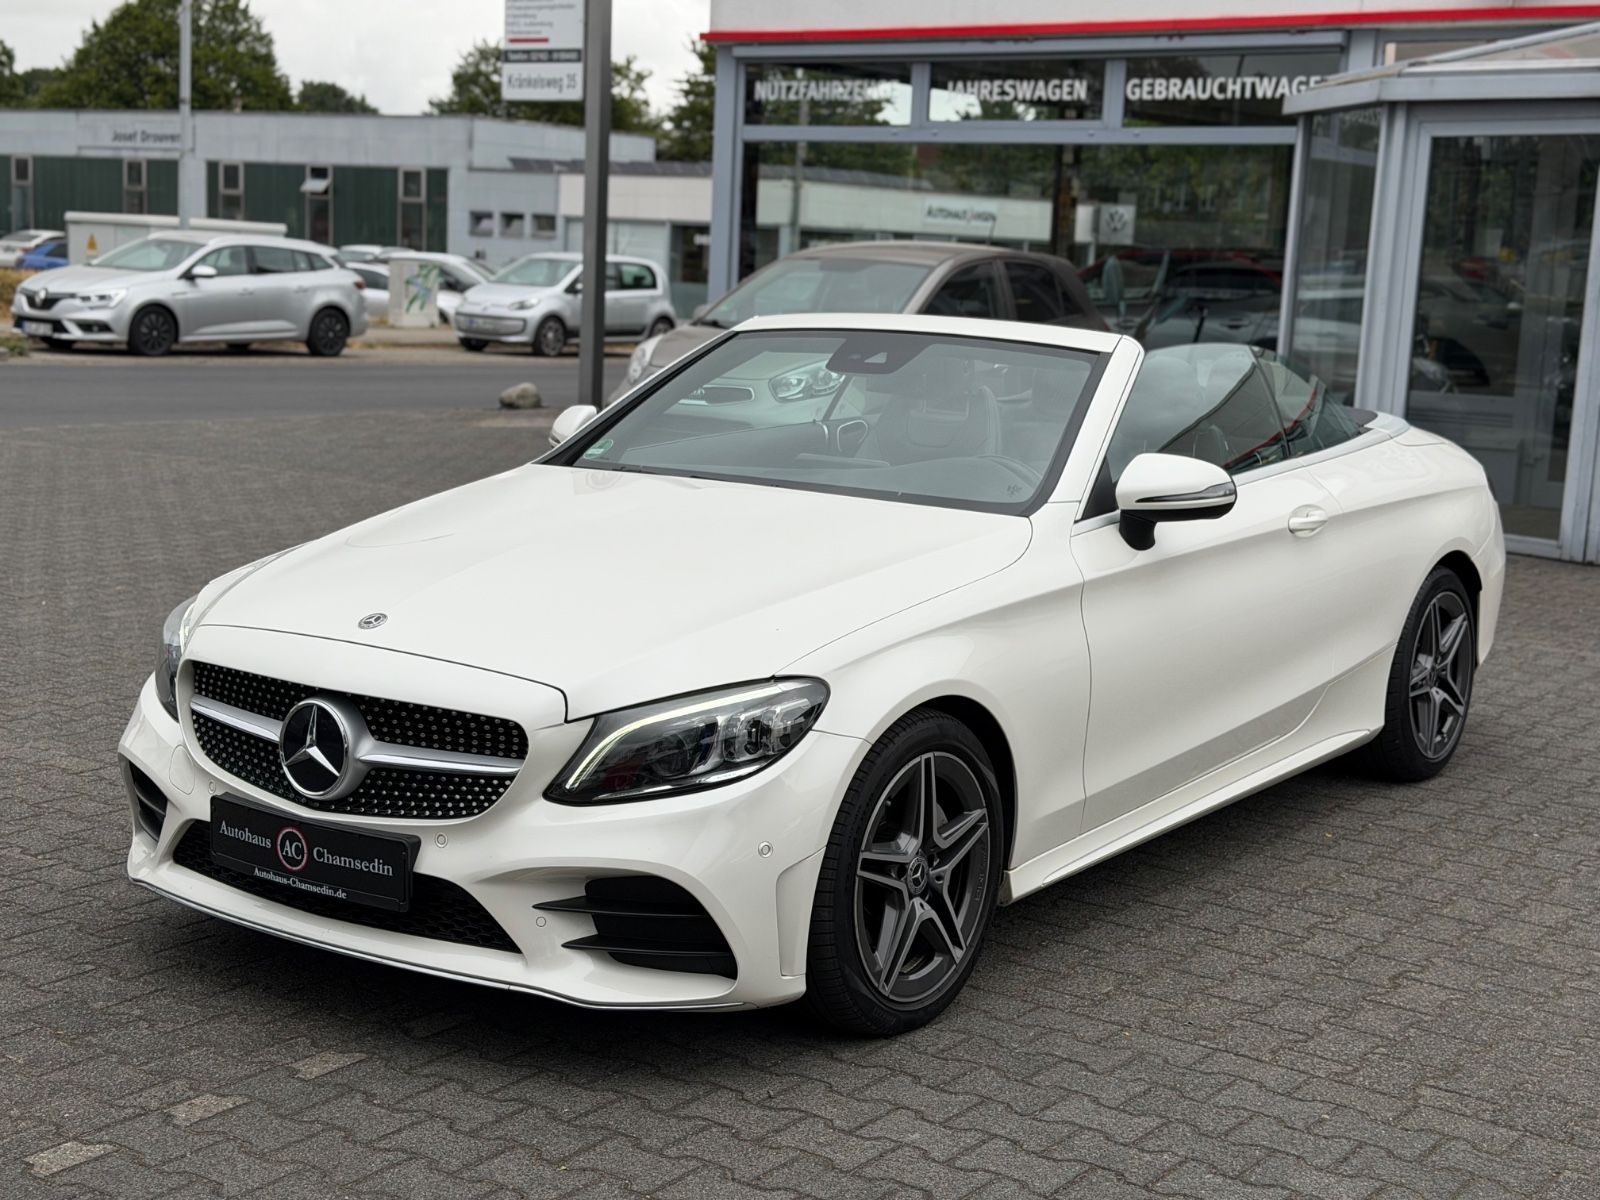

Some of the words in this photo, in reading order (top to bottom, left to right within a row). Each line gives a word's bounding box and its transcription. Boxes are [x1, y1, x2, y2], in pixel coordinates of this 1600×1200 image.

[754, 80, 900, 101] NUTZFAHRZEU
[947, 79, 1088, 101] JAHRESWAGEN
[1126, 76, 1325, 101] GEBRAUCHTWAGE
[219, 820, 272, 849] Autohaus
[282, 839, 302, 860] AC
[313, 846, 393, 876] Chamsedin
[254, 867, 347, 899] Autohaus-Chamsedin.de
